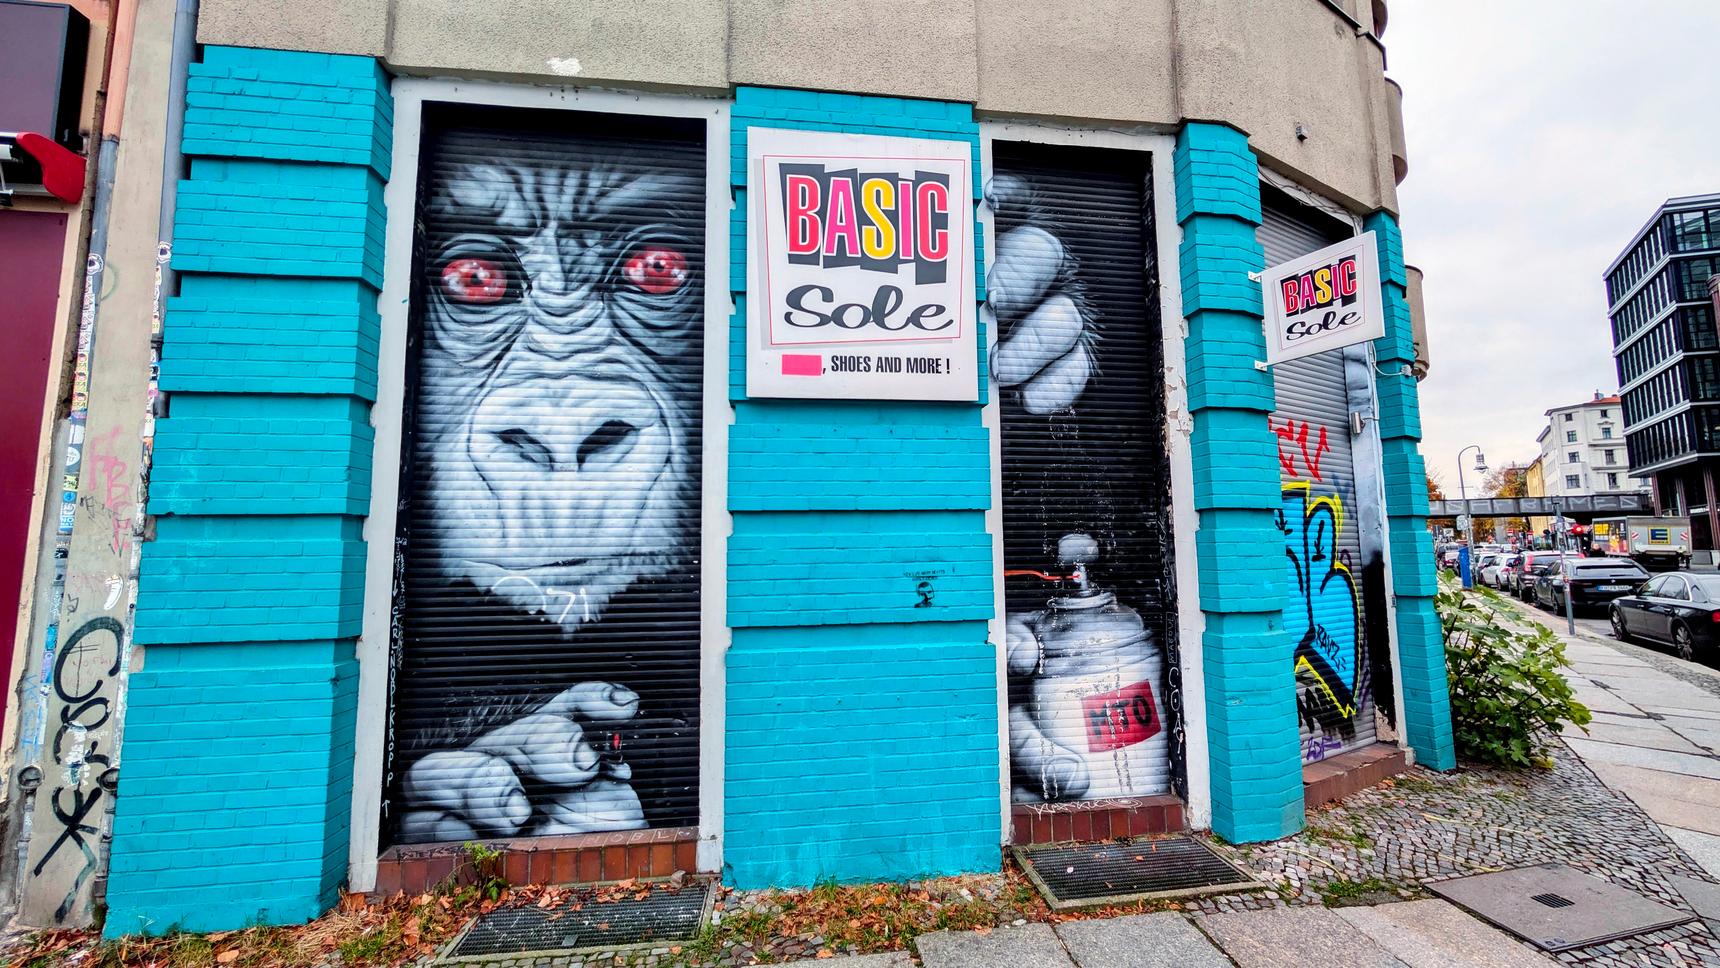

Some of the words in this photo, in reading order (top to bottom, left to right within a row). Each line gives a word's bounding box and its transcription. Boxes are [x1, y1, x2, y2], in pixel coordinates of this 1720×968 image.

[786, 174, 949, 262] BASIC
[784, 284, 954, 331] Sole
[1283, 259, 1358, 314] BASIC
[1286, 311, 1362, 341] Sole
[831, 355, 872, 373] SHOES
[876, 356, 902, 373] AND
[906, 357, 942, 374] MORE
